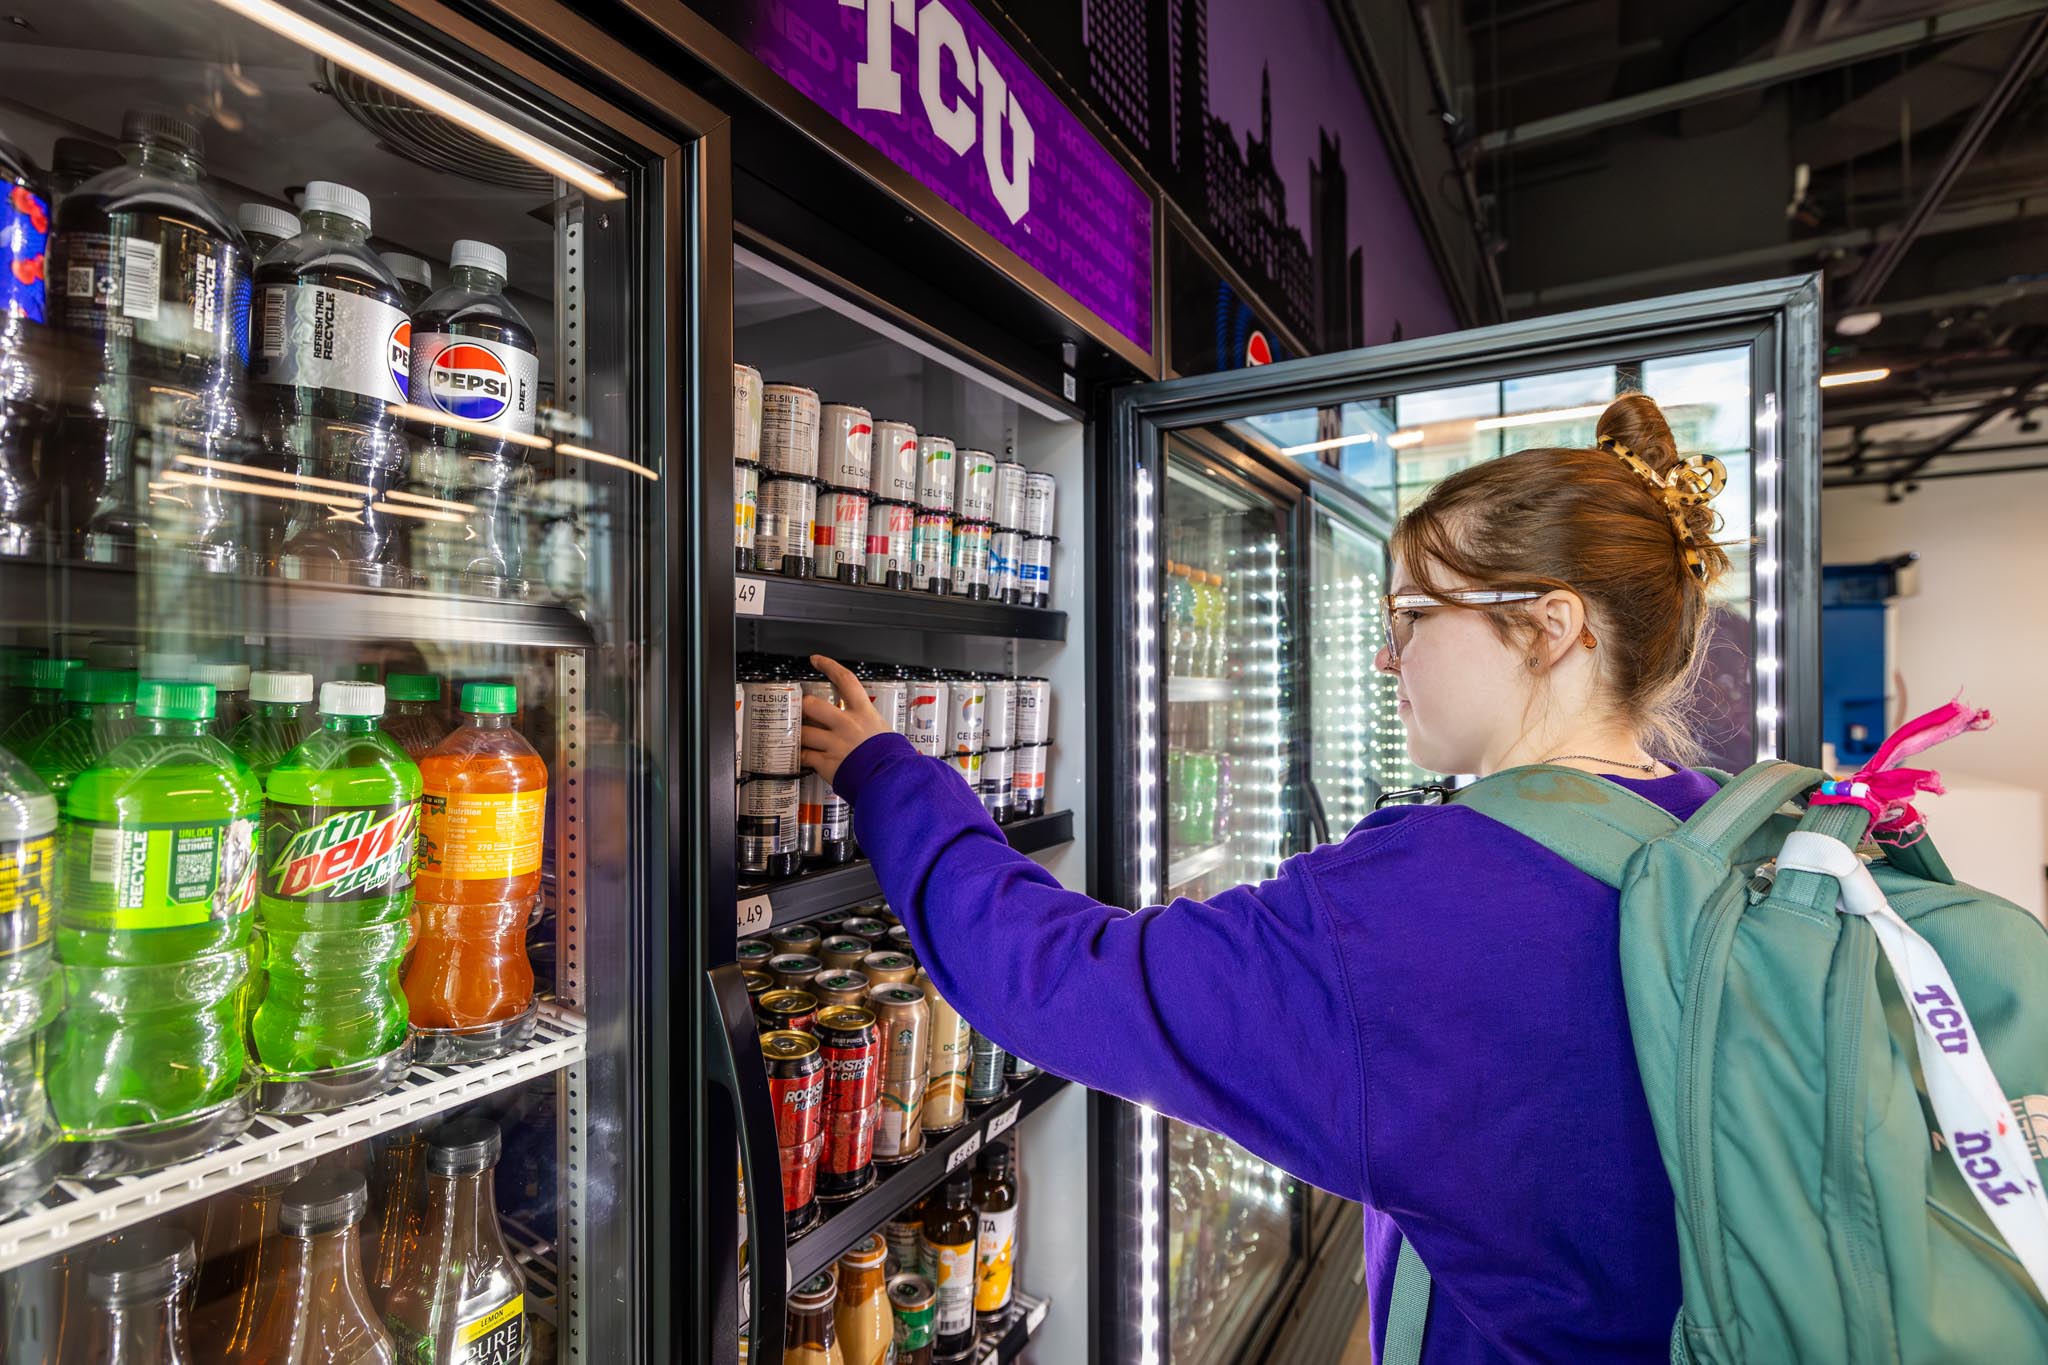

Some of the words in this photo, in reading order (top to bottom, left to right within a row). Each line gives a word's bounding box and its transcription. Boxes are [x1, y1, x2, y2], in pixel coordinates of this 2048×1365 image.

[838, 0, 1035, 225] TCU
[196, 253, 206, 281] THEN
[193, 282, 204, 330] REFRESH
[204, 256, 216, 333] RECYCLE
[315, 290, 324, 316] THEN
[313, 316, 323, 359] REFRESH
[434, 371, 507, 397] PEPSI
[519, 378, 527, 412] DIET
[763, 394, 799, 405] CELSIUS
[751, 694, 789, 703] CELSIUS
[448, 807, 482, 816] Nutrition
[128, 831, 147, 908] RECYCLE
[1913, 984, 1969, 1055] TCU
[828, 1071, 866, 1081] UNCHED
[1953, 1131, 2025, 1206] TCU
[480, 1309, 505, 1328] LEMON
[465, 1322, 519, 1361] PURE
[468, 1341, 517, 1365] EAF
